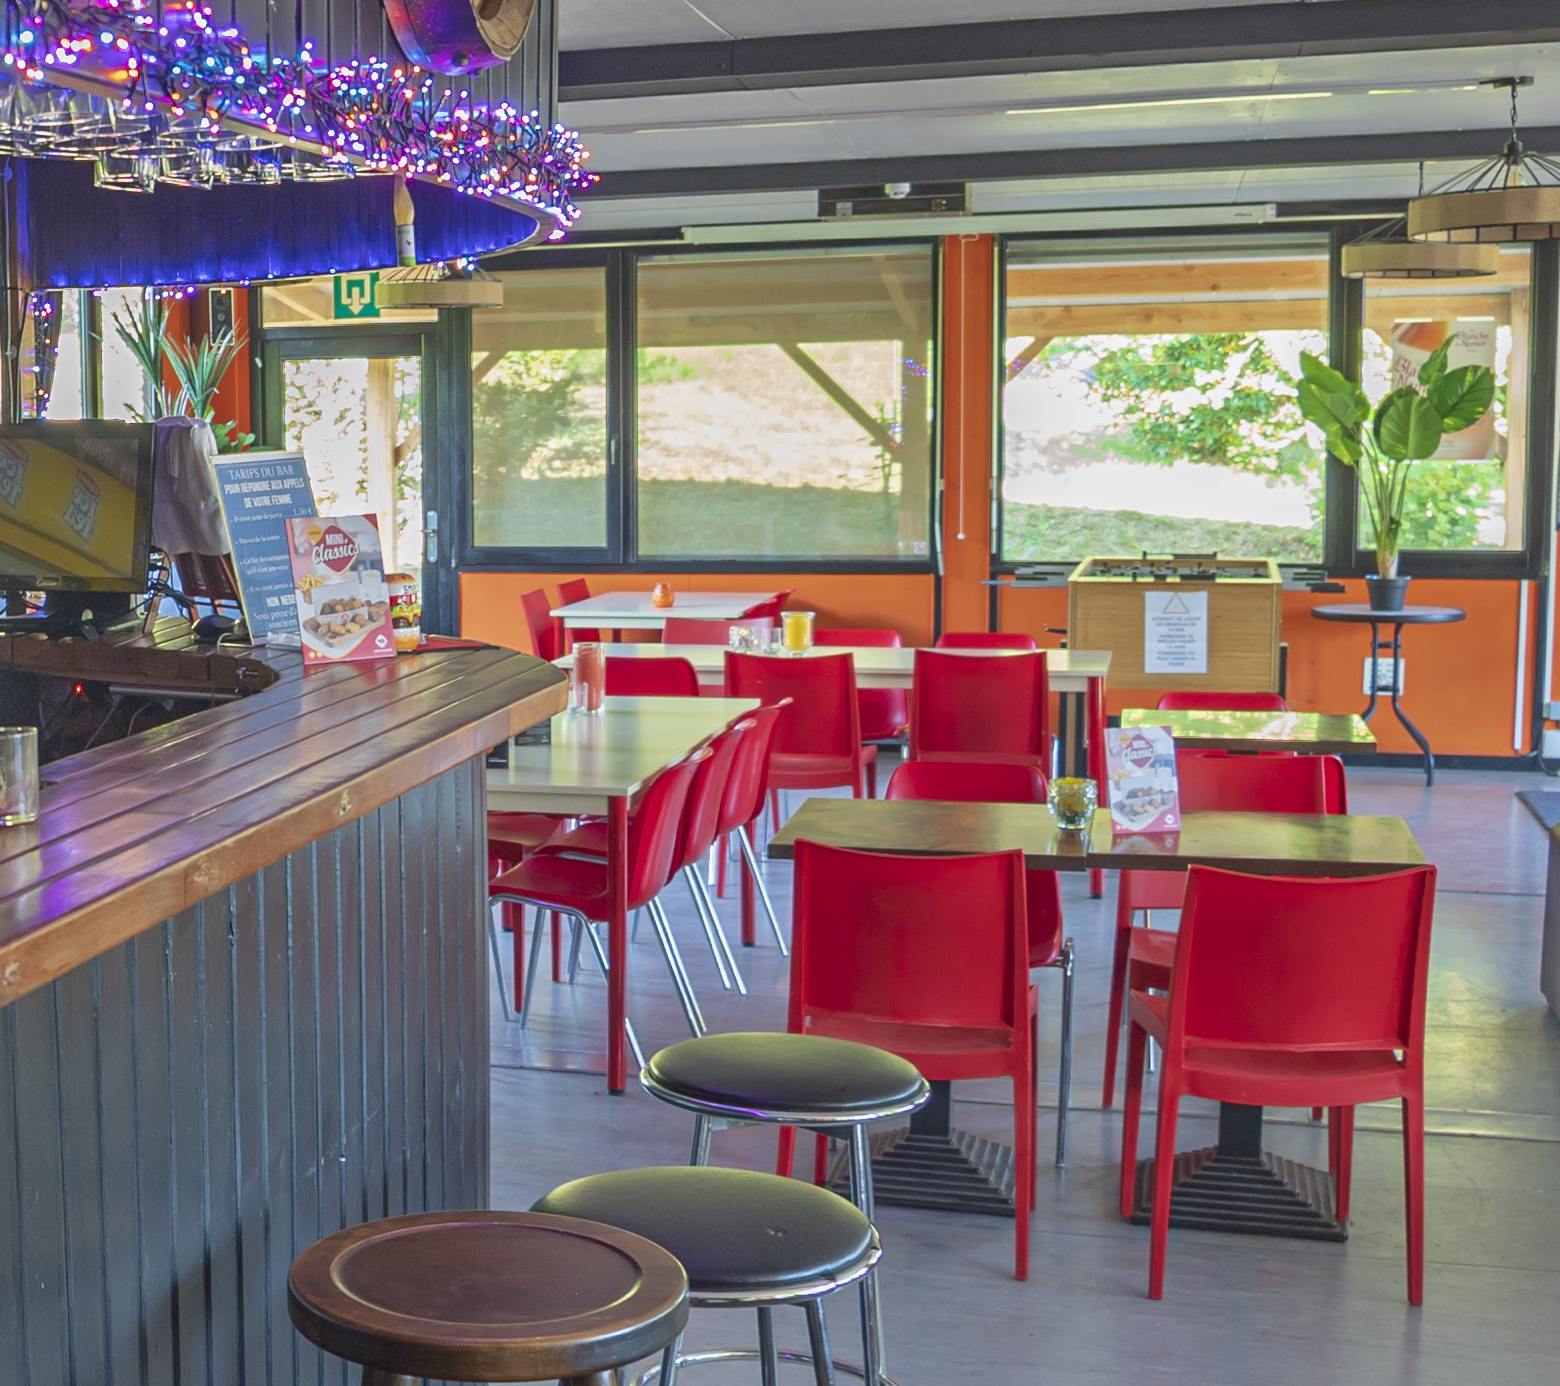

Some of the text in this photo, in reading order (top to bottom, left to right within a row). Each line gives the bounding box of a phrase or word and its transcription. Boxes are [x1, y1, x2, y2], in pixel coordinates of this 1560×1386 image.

[228, 465, 294, 480] TARIFS DU BAR
[312, 543, 359, 564] Classics
